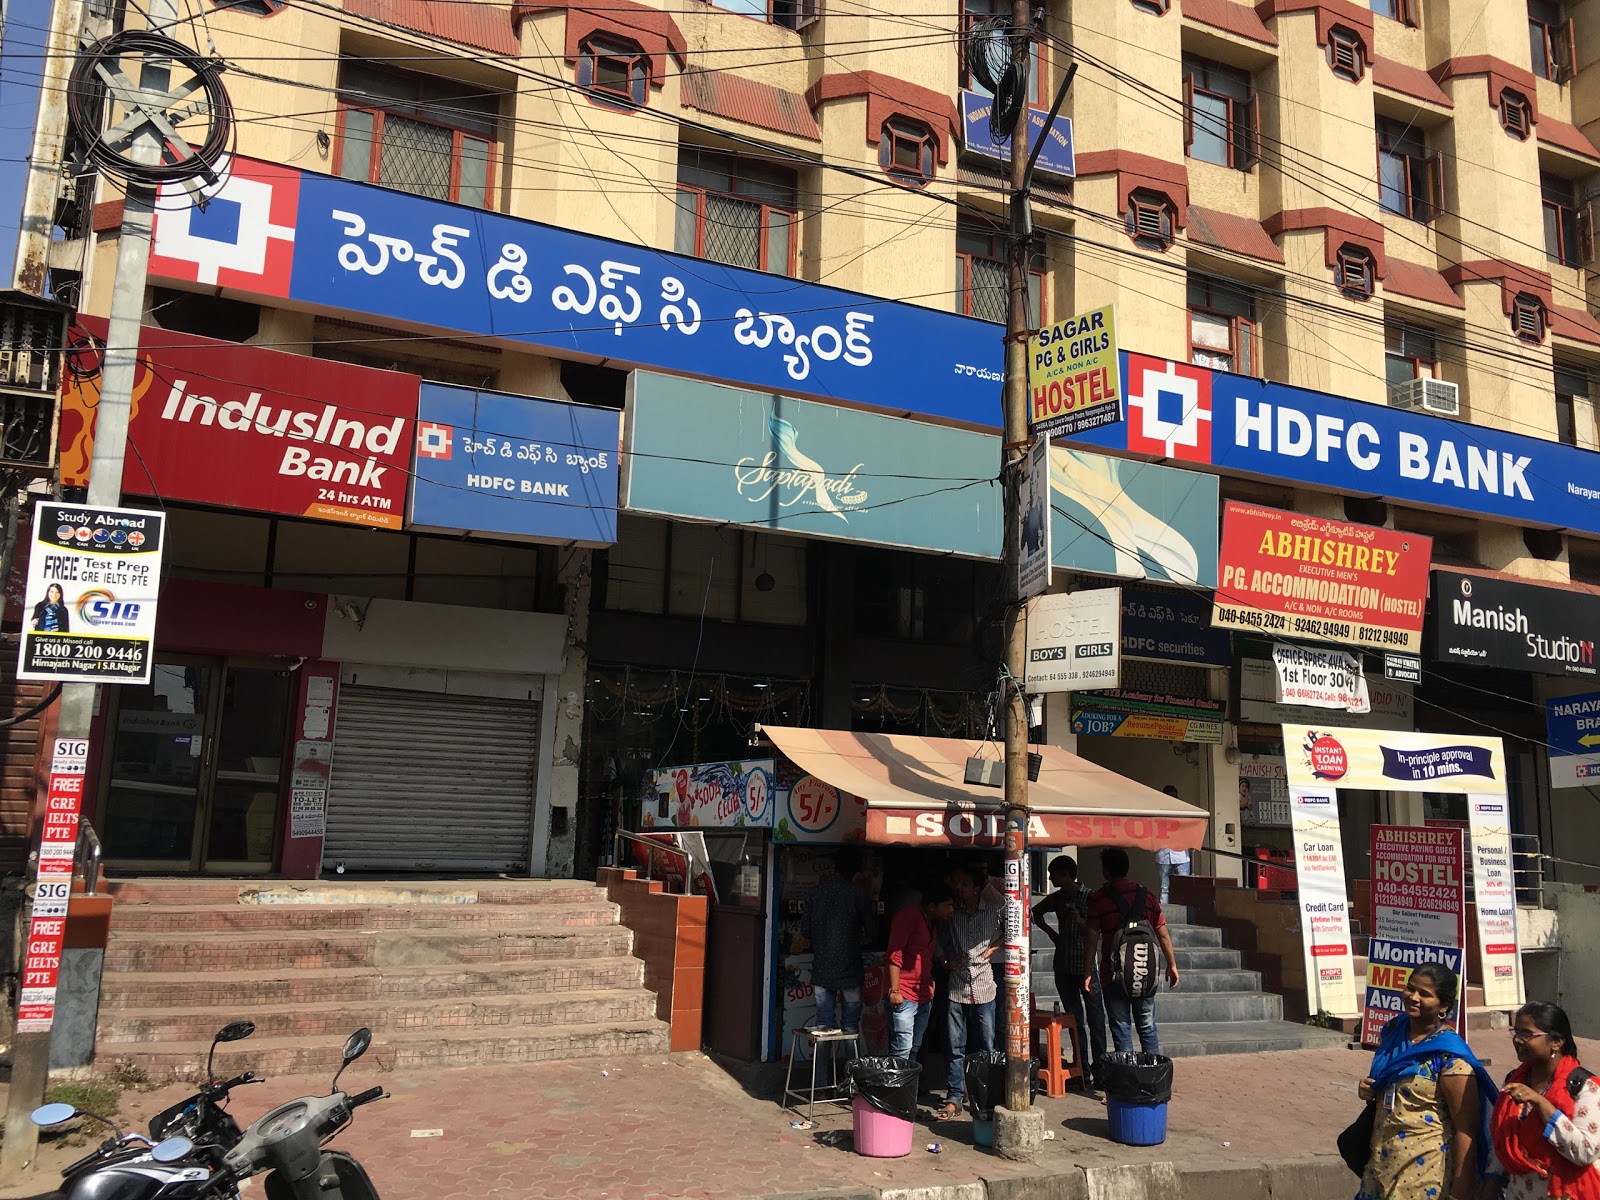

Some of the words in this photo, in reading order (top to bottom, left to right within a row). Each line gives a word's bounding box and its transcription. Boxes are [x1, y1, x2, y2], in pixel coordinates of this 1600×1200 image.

[332, 209, 470, 289] హెచ్
[487, 243, 533, 303] డి
[551, 260, 643, 336] ఎఫ్
[659, 276, 702, 335] సి
[733, 308, 875, 380] బ్యాంక్
[1038, 311, 1105, 347] SAGAR
[1035, 350, 1053, 371] PG
[1057, 346, 1066, 364] &
[1070, 332, 1109, 359] GIRLS
[1066, 361, 1084, 372] NON
[1033, 366, 1115, 419] HOSTEL
[160, 379, 406, 456] IndusInd
[1077, 412, 1116, 430] 9963277487
[499, 440, 513, 459] డి
[515, 441, 543, 467] ఎఫ్
[544, 445, 559, 464] సి
[565, 449, 608, 475] బ్యాంక్
[1235, 397, 1381, 471] HDFC
[1399, 431, 1535, 502] BANK
[278, 446, 388, 489] Bank
[467, 473, 516, 493] HDFC
[519, 479, 570, 497] BANK
[317, 488, 336, 501] 24
[337, 491, 359, 504] hrs
[360, 495, 392, 510] ATM
[57, 511, 91, 526] Study
[95, 514, 145, 529] Abroad
[1229, 505, 1282, 521] www.abhishrey.in
[1258, 529, 1400, 577] ABHISHREY
[43, 555, 80, 581] FREE
[83, 558, 112, 570] Test
[117, 560, 150, 575] Prep
[1298, 564, 1336, 579] EXECUTIVE
[1336, 570, 1358, 582] MEN'S
[81, 570, 99, 583] GRE
[103, 573, 127, 585] IELTS
[131, 575, 148, 587] PTE
[1222, 564, 1248, 591] PG.
[1250, 570, 1380, 611] ACCOMMODATION
[1380, 592, 1422, 619] (HOSTEL)
[92, 601, 141, 620] SIG
[1284, 600, 1298, 610] A/C
[1306, 602, 1322, 614] NON
[1324, 606, 1338, 617] A/C
[1338, 607, 1364, 620] ROOMS
[1452, 599, 1528, 635] Manish
[1218, 607, 1263, 627] 040-6455
[1263, 613, 1285, 630] 2424
[1294, 617, 1322, 635] 92462
[1322, 621, 1350, 638] 94949
[1358, 626, 1382, 642] 81212
[1382, 629, 1409, 646] 94949
[33, 643, 71, 657] 1800
[74, 645, 102, 659] 200
[106, 647, 142, 661] 9446
[1033, 647, 1064, 661] BOY'S
[1078, 644, 1110, 656] GIRLS
[1157, 640, 1205, 657] securities
[31, 658, 70, 669] Himayath
[72, 660, 96, 670] Nagar
[102, 661, 141, 673] S.R.Nagar
[1276, 647, 1303, 666] OFFICE
[1303, 649, 1327, 669] SPACE
[1027, 674, 1048, 683] Contact:
[1282, 665, 1299, 683] 1st
[1302, 668, 1327, 687] Floor
[1164, 695, 1195, 707] Financial
[1081, 711, 1105, 721] LOOKING
[1086, 720, 1115, 735] JOB?
[57, 742, 86, 756] SIG
[1314, 745, 1343, 756] INSTANT
[1317, 754, 1344, 765] LOAN
[1397, 751, 1440, 767] In-principle
[1441, 750, 1474, 763] approval
[1239, 762, 1272, 778] MANISH
[1316, 763, 1346, 772] CARNIVAL
[1412, 767, 1421, 779] in
[1422, 765, 1435, 779] 10
[1437, 762, 1464, 776] mins.
[52, 778, 82, 792] FREE
[50, 797, 76, 810] GRE
[48, 812, 79, 825] IELTS
[45, 826, 70, 839] PTE
[1066, 816, 1181, 840] STOP
[1376, 829, 1454, 845] ABHISHREY
[1303, 842, 1317, 852] Car
[1317, 843, 1335, 852] Loan
[1375, 843, 1410, 852] EXECUTIVE
[1410, 845, 1434, 854] PAYING
[1435, 846, 1456, 855] GUEST
[1477, 845, 1503, 855] Personal
[1376, 851, 1424, 862] ACCOMMODATION
[1425, 855, 1437, 863] FOR
[1437, 856, 1456, 865] MEN'S
[1479, 857, 1507, 866] Business
[1310, 864, 1337, 872] NetBanking
[1375, 860, 1460, 887] HOSTEL
[1487, 869, 1501, 878] Loan
[37, 883, 67, 898] SIG
[1376, 881, 1458, 899] 040-64552424
[1305, 902, 1328, 913] Credit
[1327, 902, 1345, 913] Card
[1374, 893, 1413, 907] 8121294949
[1418, 898, 1460, 912] 9246294949
[1480, 907, 1498, 916] Home
[32, 920, 62, 935] FREE
[1310, 916, 1332, 924] Lifetime
[1385, 917, 1409, 926] Bedrooms
[30, 941, 56, 954] GRE
[1373, 941, 1458, 970] Monthly
[27, 957, 59, 969] IELTS
[25, 971, 51, 984] PTE
